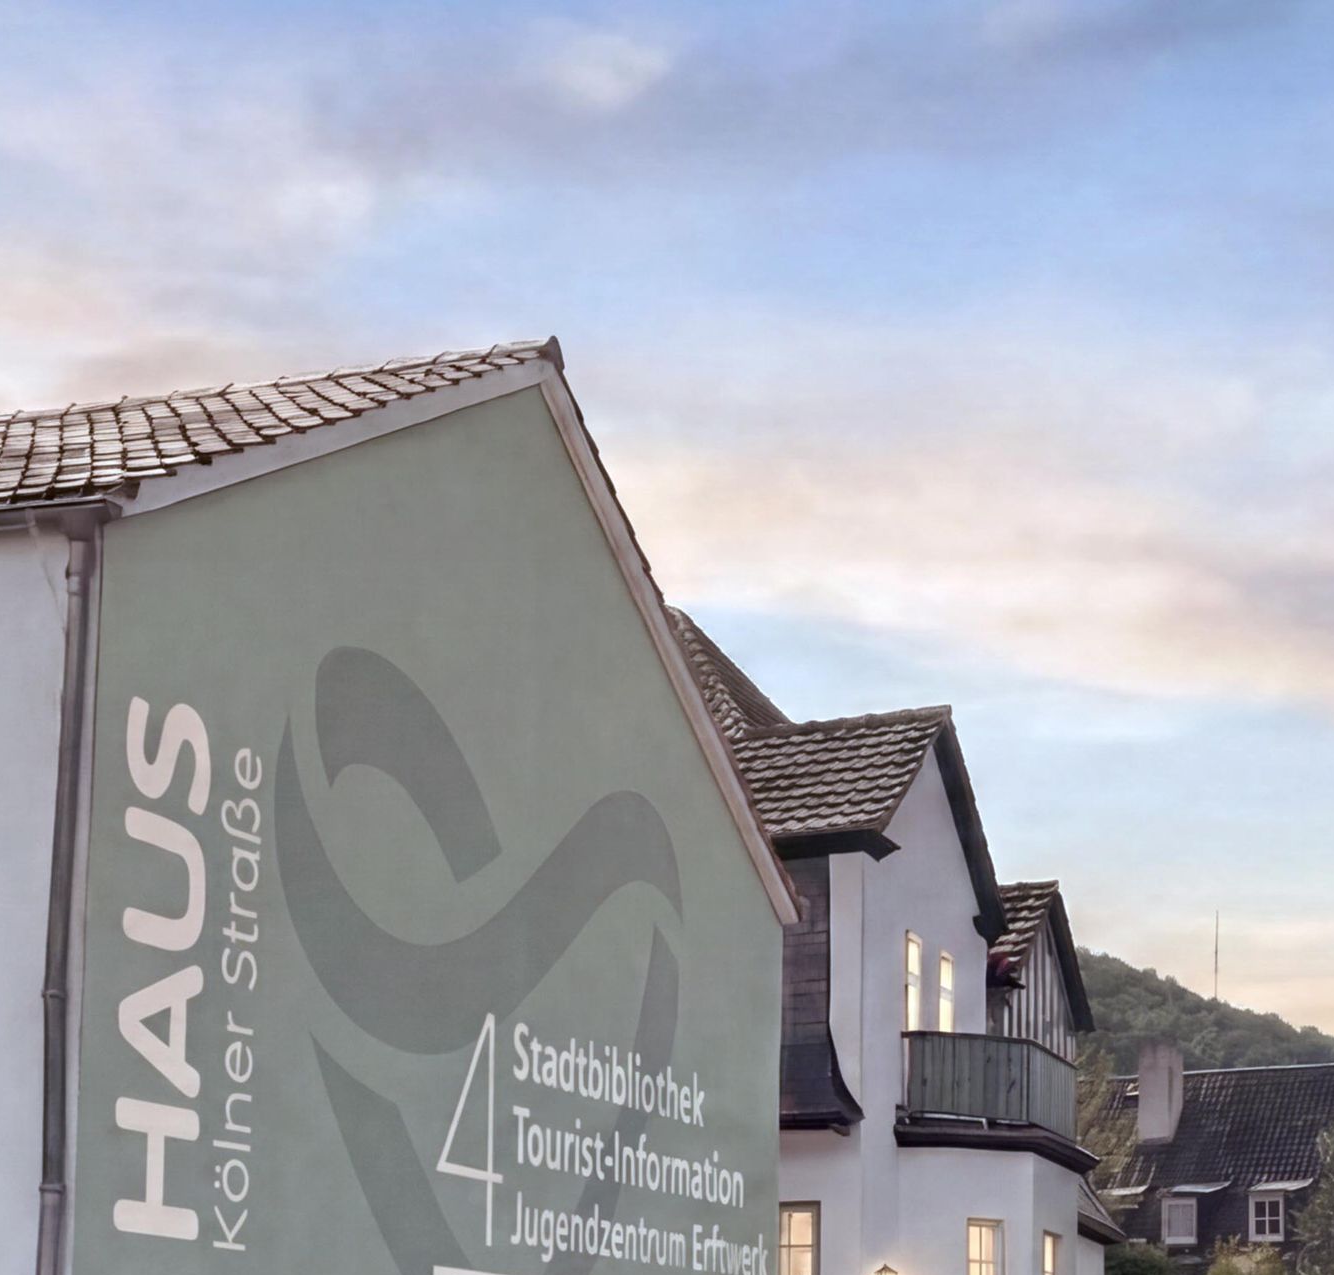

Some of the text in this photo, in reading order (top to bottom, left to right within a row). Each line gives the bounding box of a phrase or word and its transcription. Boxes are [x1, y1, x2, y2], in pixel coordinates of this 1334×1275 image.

[113, 695, 212, 1241] HAUS
[213, 747, 263, 1251] Kölner Straße
[435, 1012, 504, 1247] 4
[512, 1022, 705, 1128] Stadtbibliothek
[512, 1104, 745, 1209] Tourist-Information
[510, 1191, 686, 1263] Jugendzentrum
